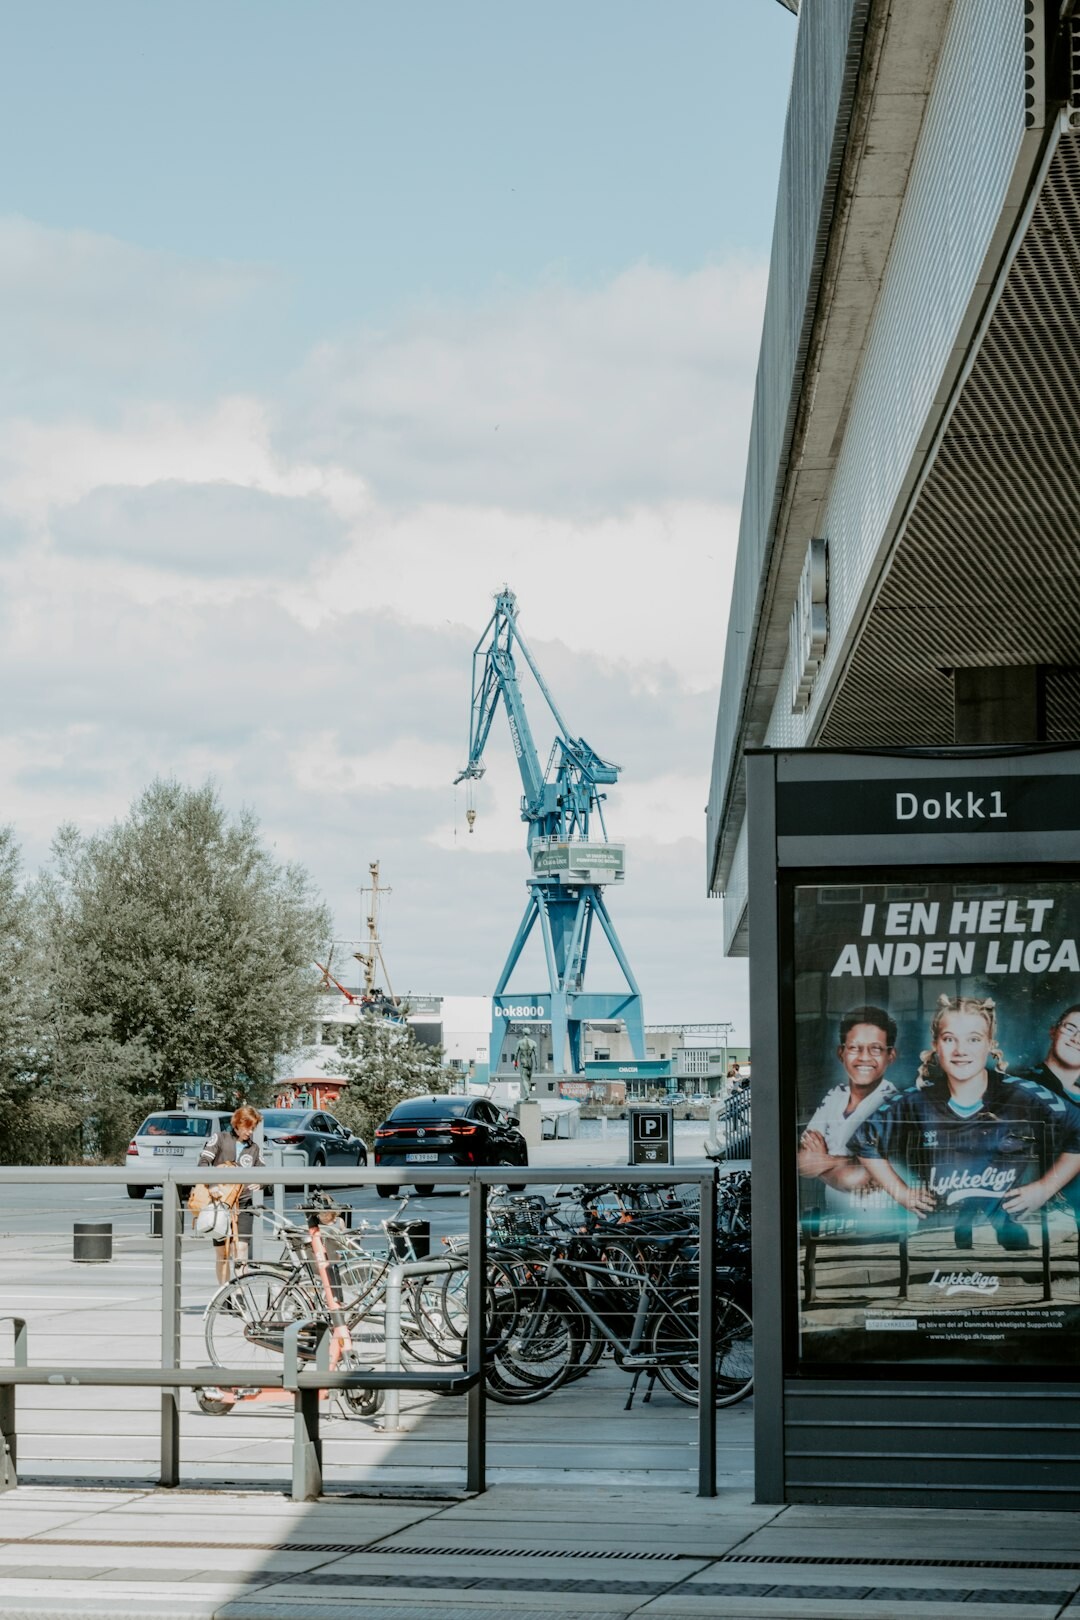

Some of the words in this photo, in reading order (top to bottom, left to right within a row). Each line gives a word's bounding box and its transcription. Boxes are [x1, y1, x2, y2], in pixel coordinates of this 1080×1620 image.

[508, 714, 523, 758] Dok8000
[895, 791, 1008, 820] Dokk1
[861, 903, 876, 936] I
[884, 902, 940, 936] EN
[949, 899, 1054, 934] HELT
[830, 941, 976, 977] ANDEN
[984, 939, 1080, 974] LIGA
[494, 1005, 545, 1017] Dok8000
[645, 1119, 657, 1135] P
[929, 1166, 1016, 1195] Lykkeliga
